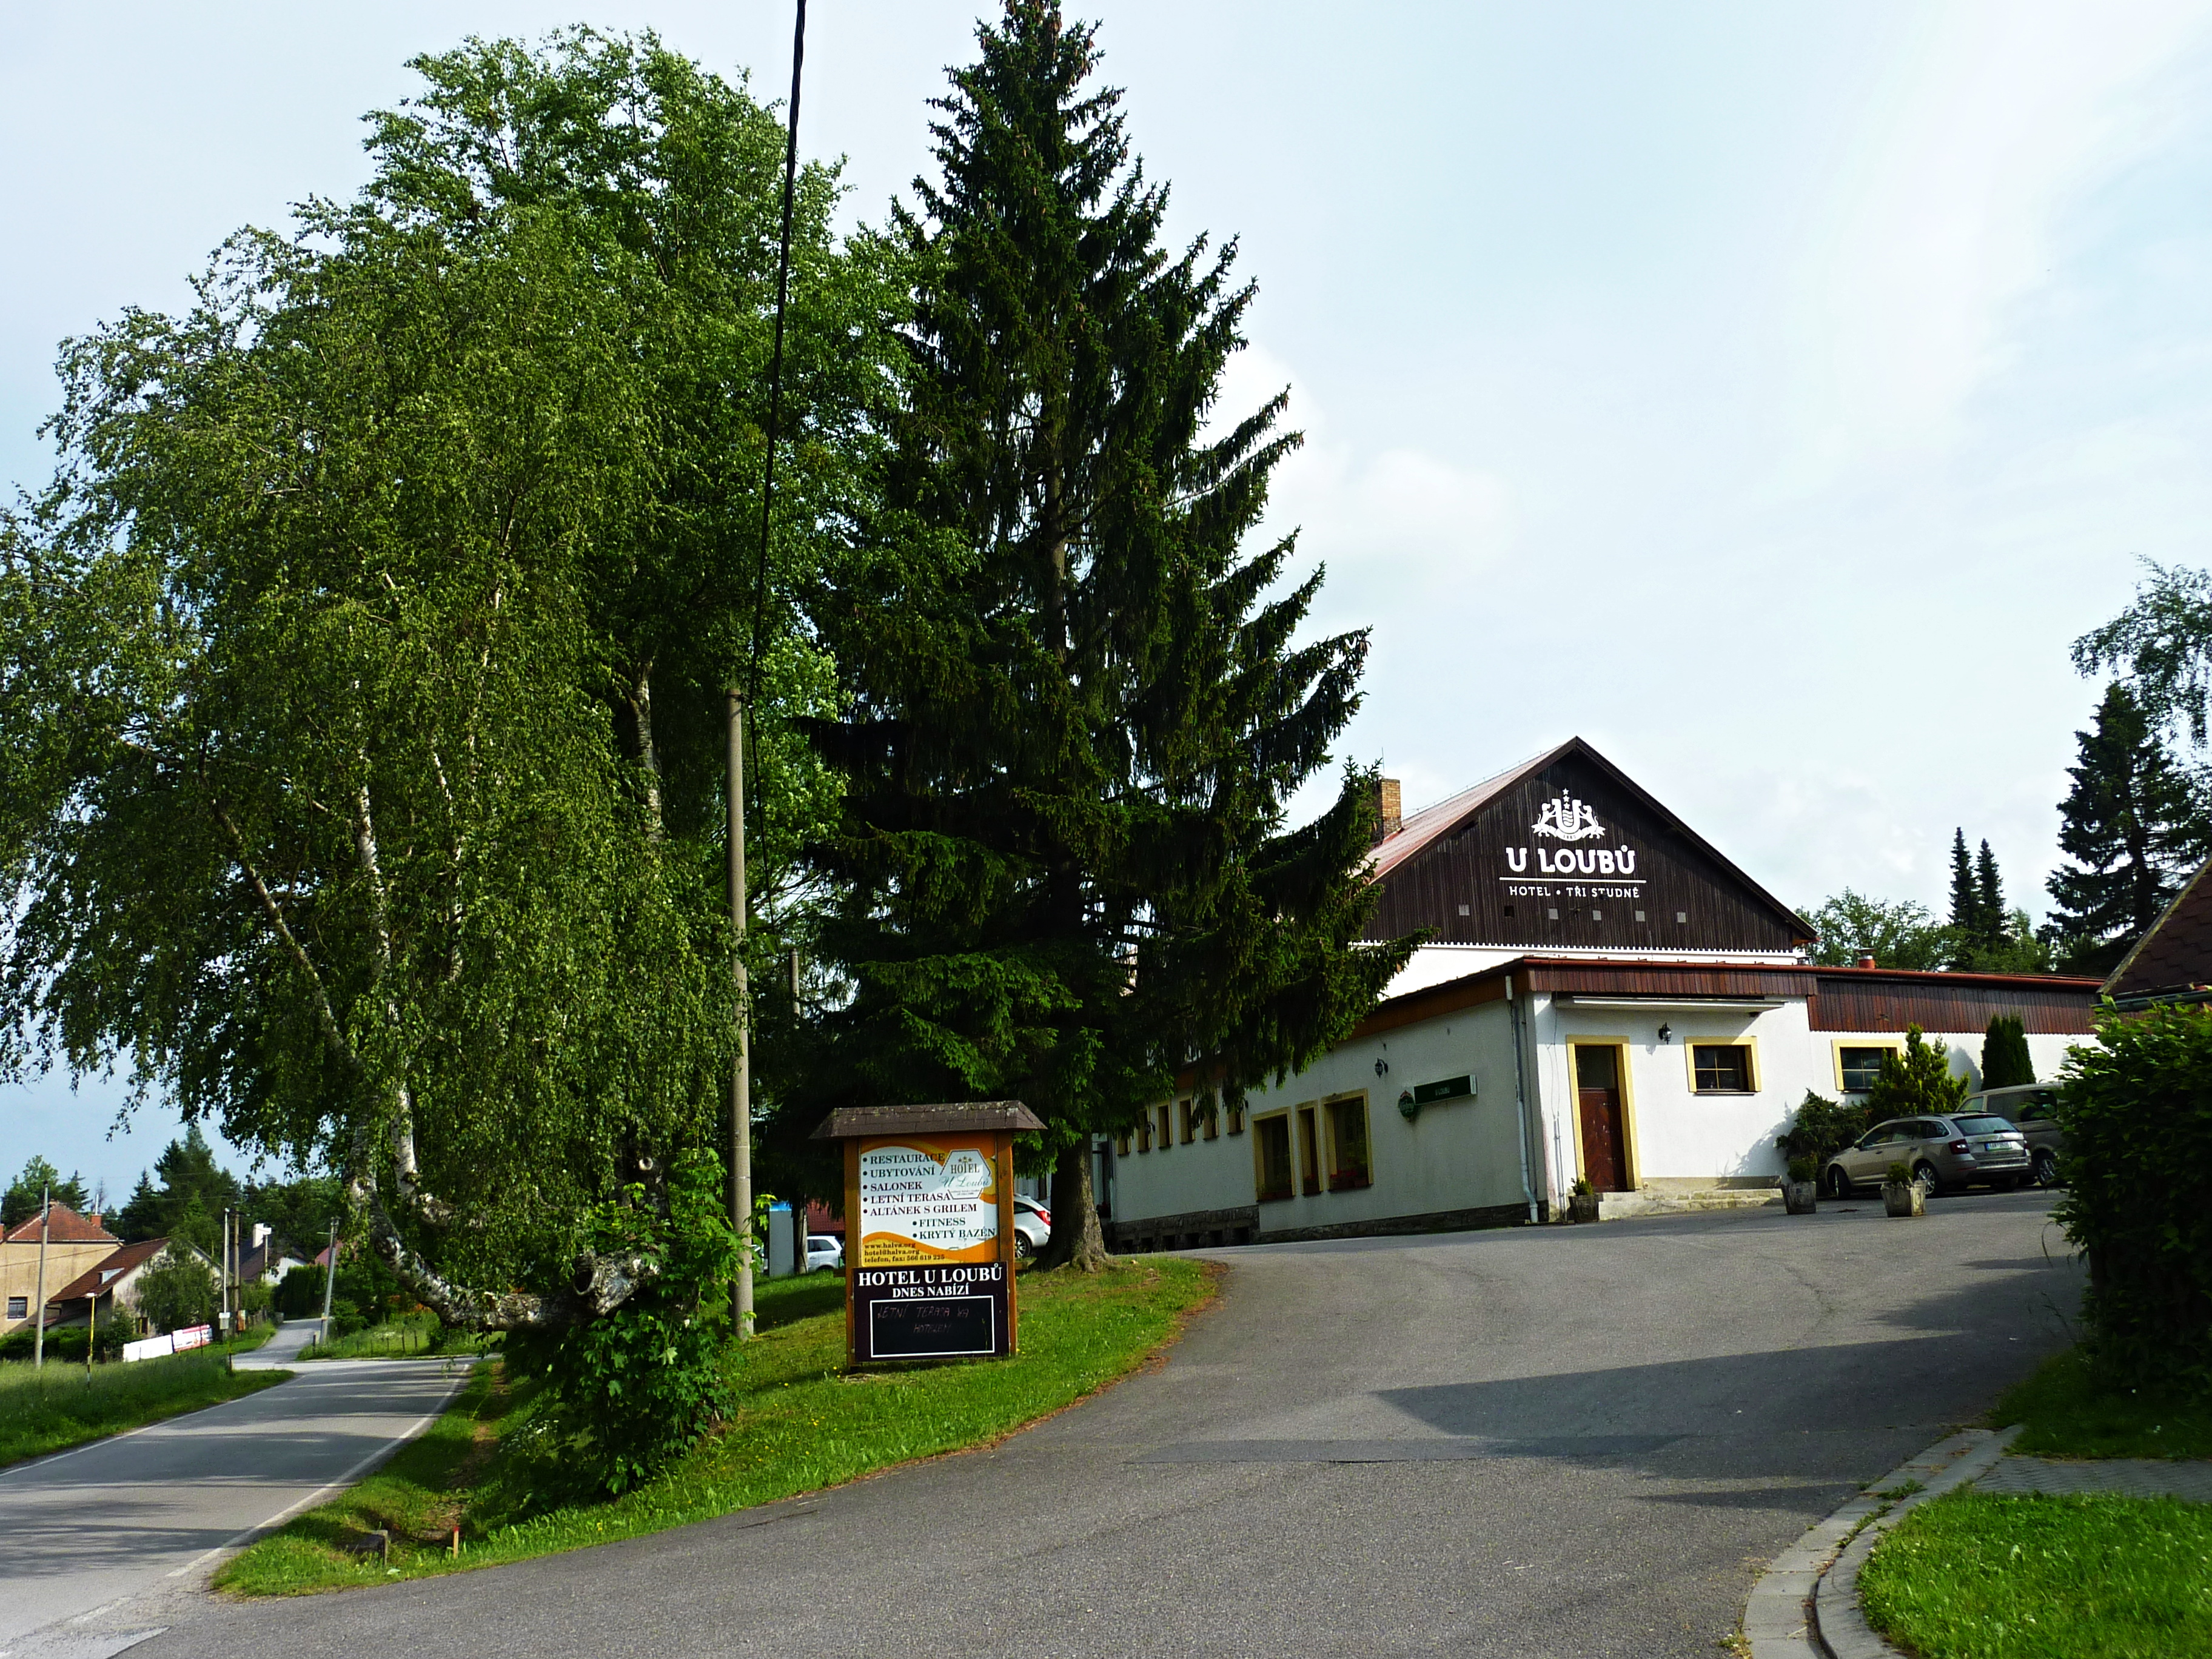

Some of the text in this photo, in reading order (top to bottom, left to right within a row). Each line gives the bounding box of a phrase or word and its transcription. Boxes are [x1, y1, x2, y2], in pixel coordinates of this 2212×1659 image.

[1506, 845, 1635, 874] U LOUBŮ
[1509, 886, 1551, 897] HOTEL
[1566, 885, 1587, 897] TŘI
[870, 1153, 945, 1165] RESTAURACE
[870, 1164, 936, 1179] UBYTOVÁNÍ
[951, 1161, 980, 1175] HOTEL
[870, 1181, 923, 1192] SALONEK
[871, 1192, 951, 1204] LETNÍ TERASA
[870, 1204, 977, 1216] ALTÁNEK S GRILEM
[919, 1217, 966, 1227] FITNESS
[919, 1226, 996, 1239] KRYTÝ BAZÉN
[858, 1262, 1002, 1286] HOTEL U LOUBŮ
[892, 1282, 970, 1298] DNES NABÍZÍ
